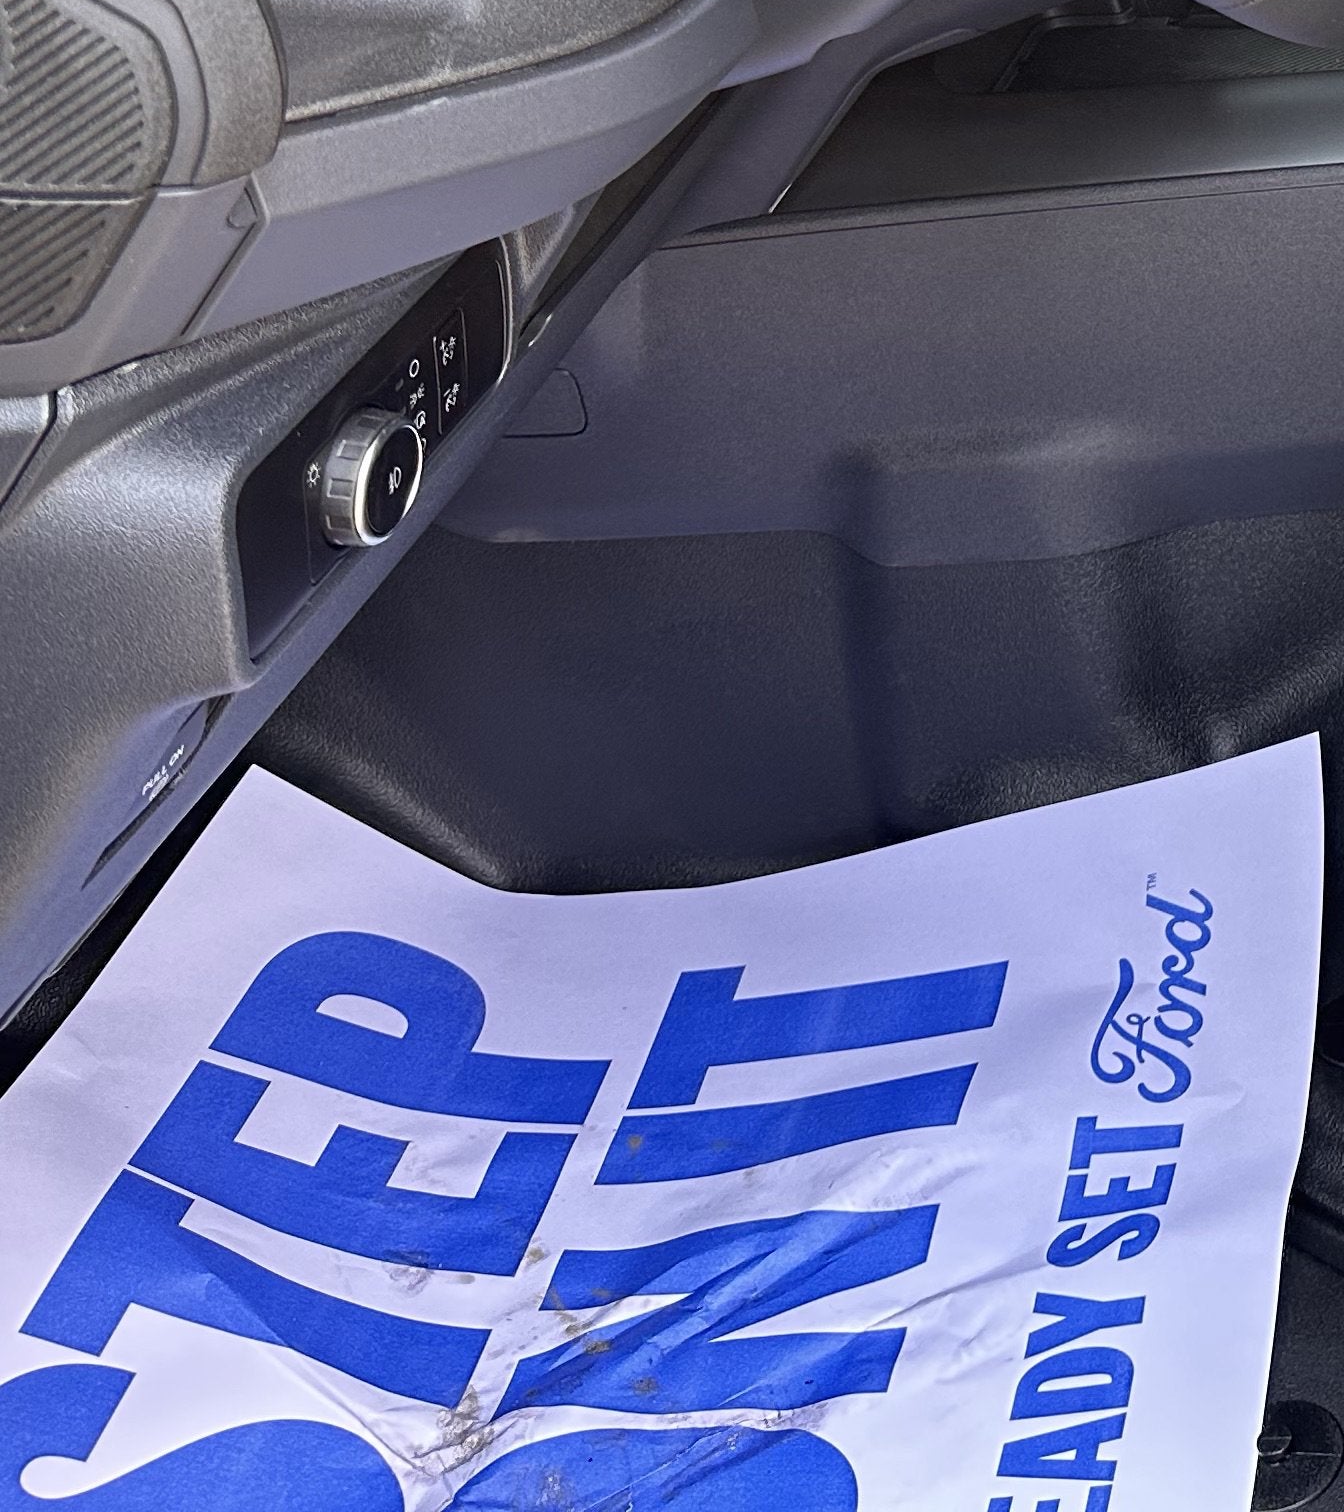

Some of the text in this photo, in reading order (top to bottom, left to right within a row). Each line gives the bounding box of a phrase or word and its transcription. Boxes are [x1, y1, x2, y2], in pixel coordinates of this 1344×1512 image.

[594, 961, 1009, 1185] IT
[1091, 889, 1214, 1104] Ford
[1047, 1115, 1185, 1267] SET
